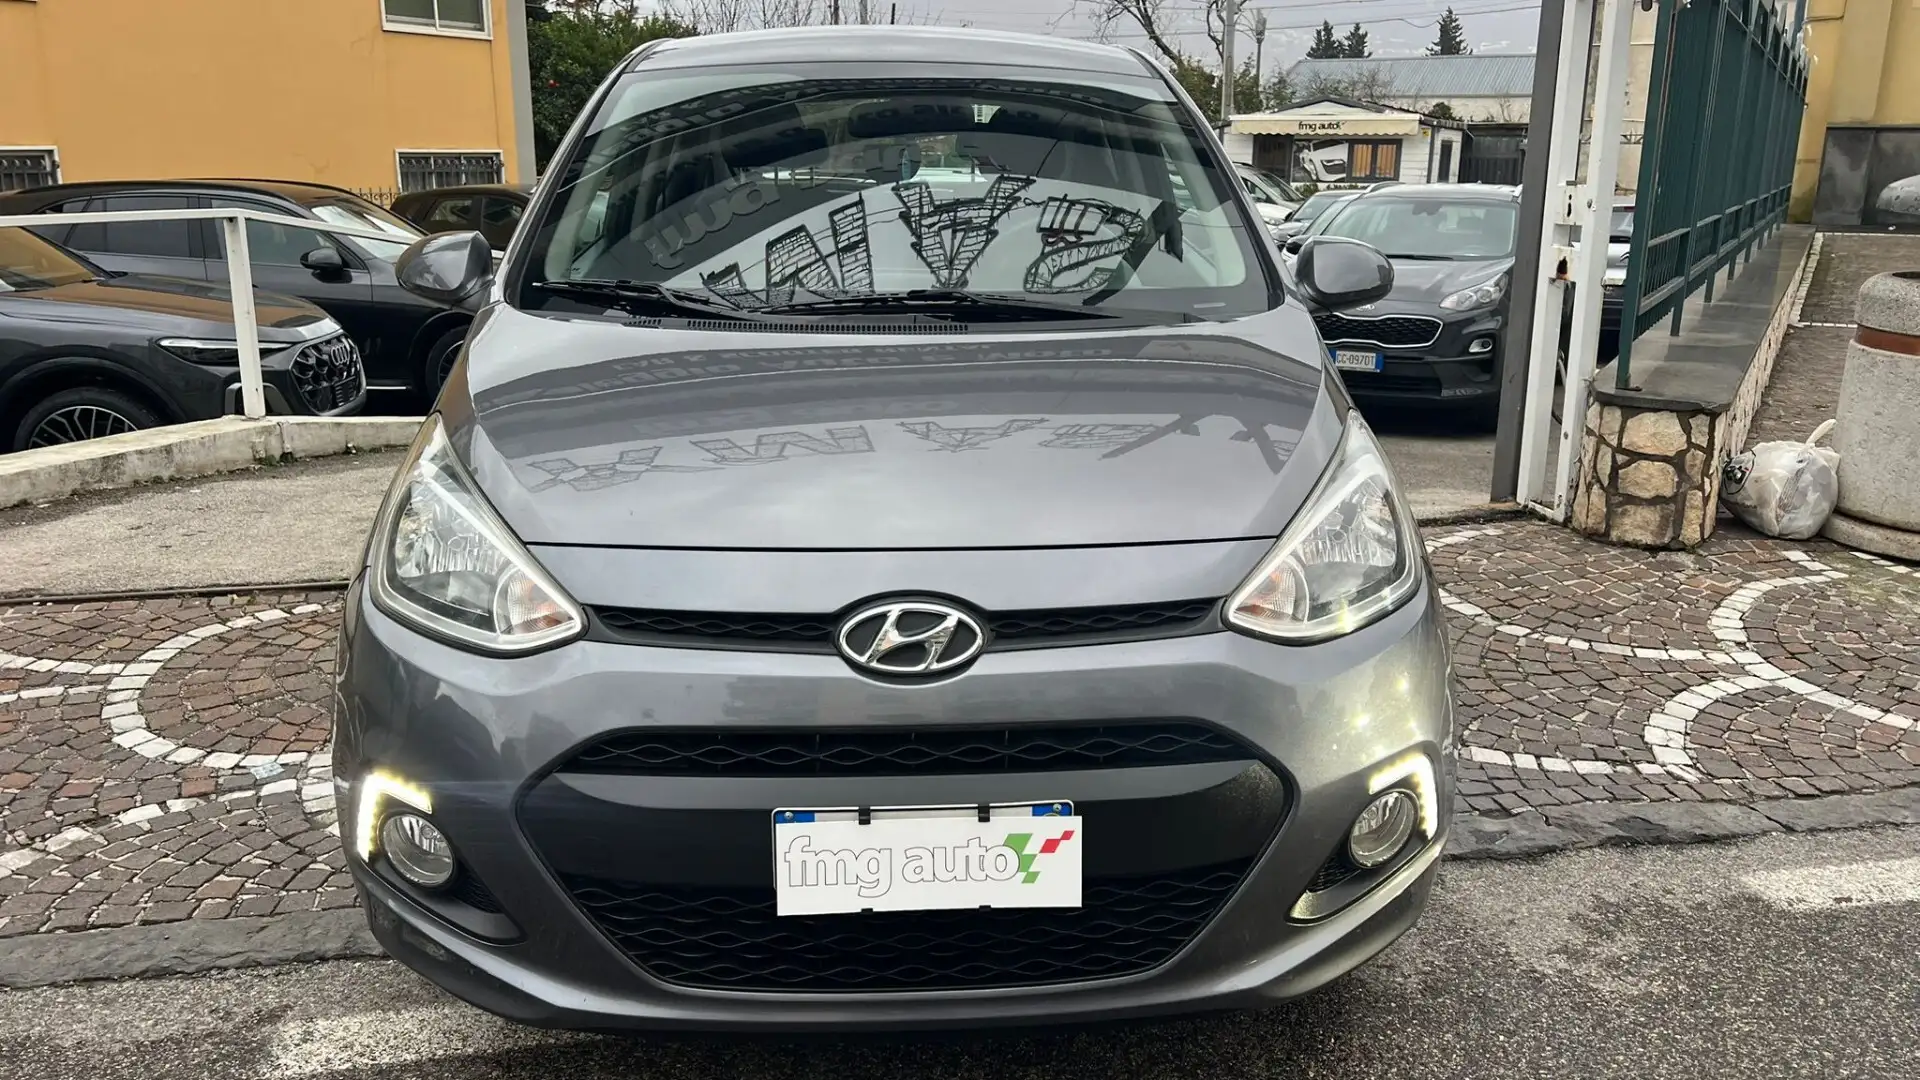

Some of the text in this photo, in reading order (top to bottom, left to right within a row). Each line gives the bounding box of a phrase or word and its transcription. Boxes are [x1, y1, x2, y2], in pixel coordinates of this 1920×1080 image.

[1298, 121, 1340, 132] fmg auto
[784, 835, 1021, 898] fmg auto
